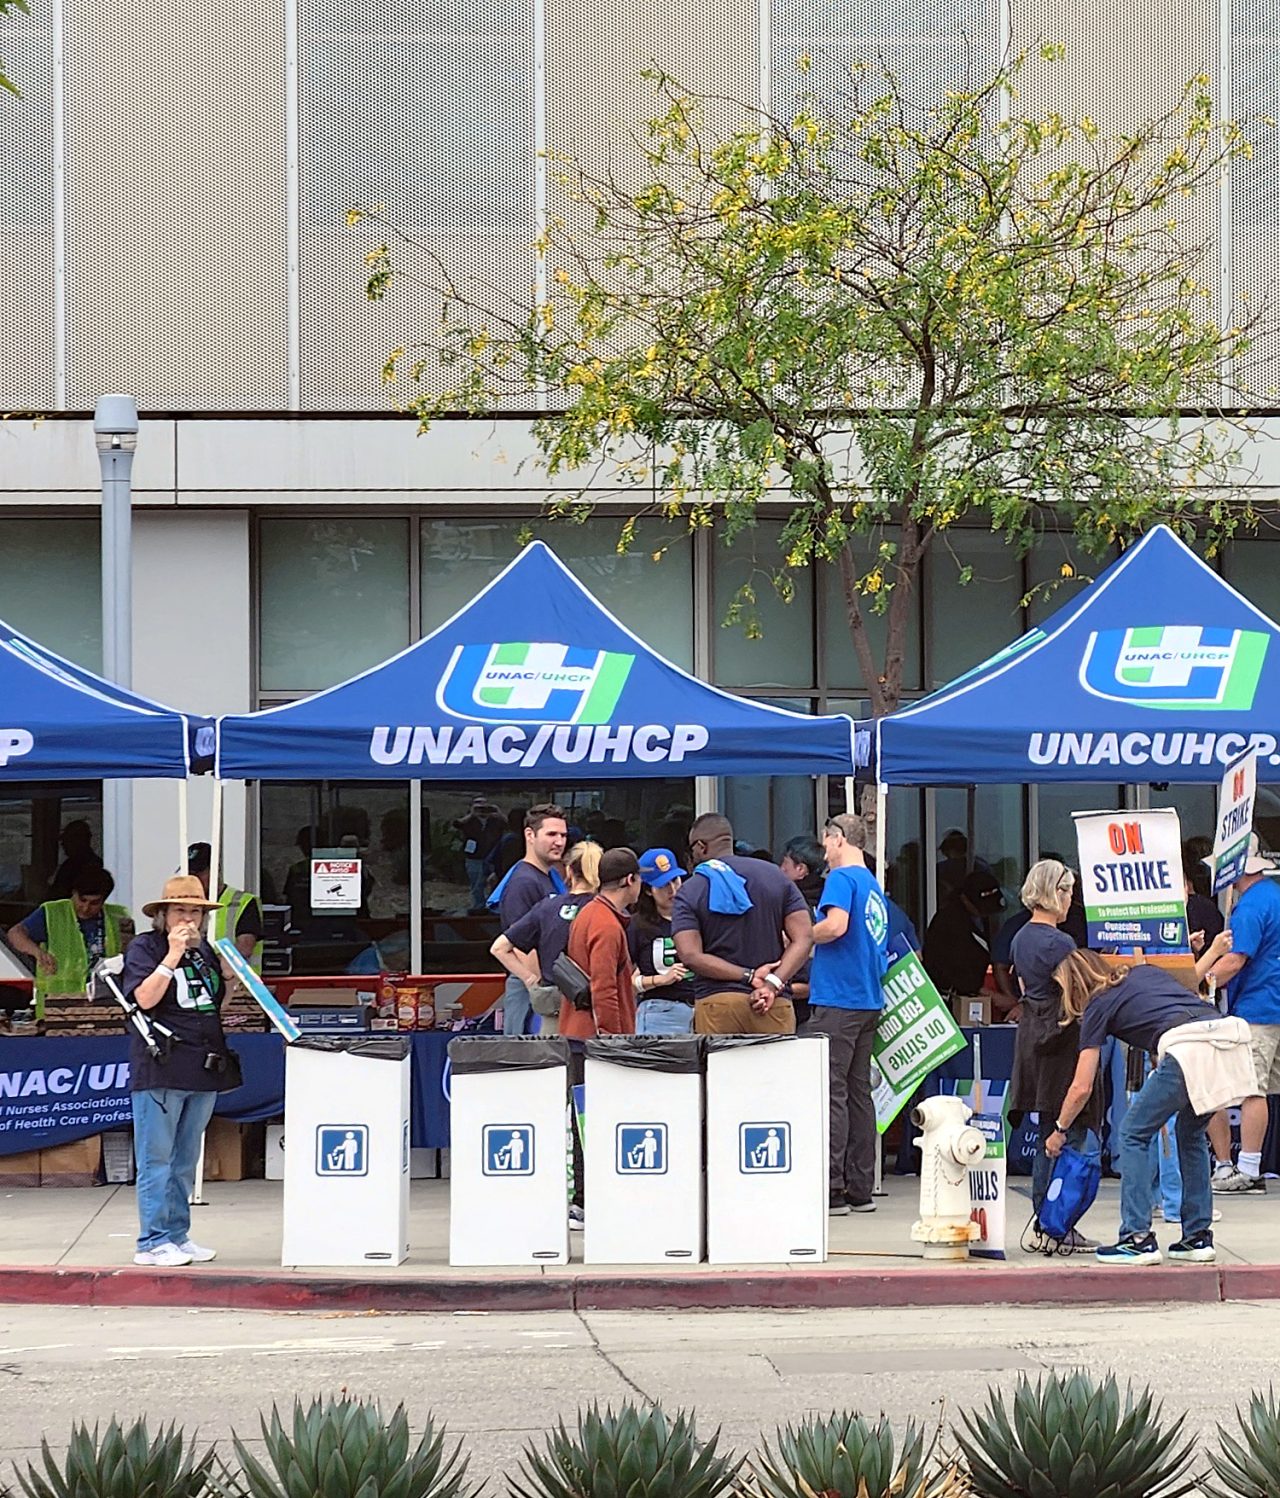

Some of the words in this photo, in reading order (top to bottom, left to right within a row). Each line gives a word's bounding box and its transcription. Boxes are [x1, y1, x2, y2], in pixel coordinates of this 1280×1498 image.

[1124, 652, 1230, 661] UNAC/UHCP
[486, 672, 591, 682] UNAC/UHCP
[369, 723, 709, 767] UNAC/UHCP
[1221, 796, 1251, 841] STRIKE
[1107, 821, 1145, 855] ON
[1093, 860, 1172, 893] STRIKE
[879, 962, 926, 1018] PATI
[899, 995, 926, 1025] FOR
[877, 1014, 902, 1043] OUR
[924, 1018, 947, 1038] On
[888, 1033, 928, 1071] Strike
[6, 1103, 49, 1116] Nurses
[51, 1096, 130, 1112] Associations
[15, 1117, 56, 1130] Health
[60, 1115, 89, 1126] Care
[92, 1110, 134, 1123] Profes
[969, 1171, 998, 1201] STRI
